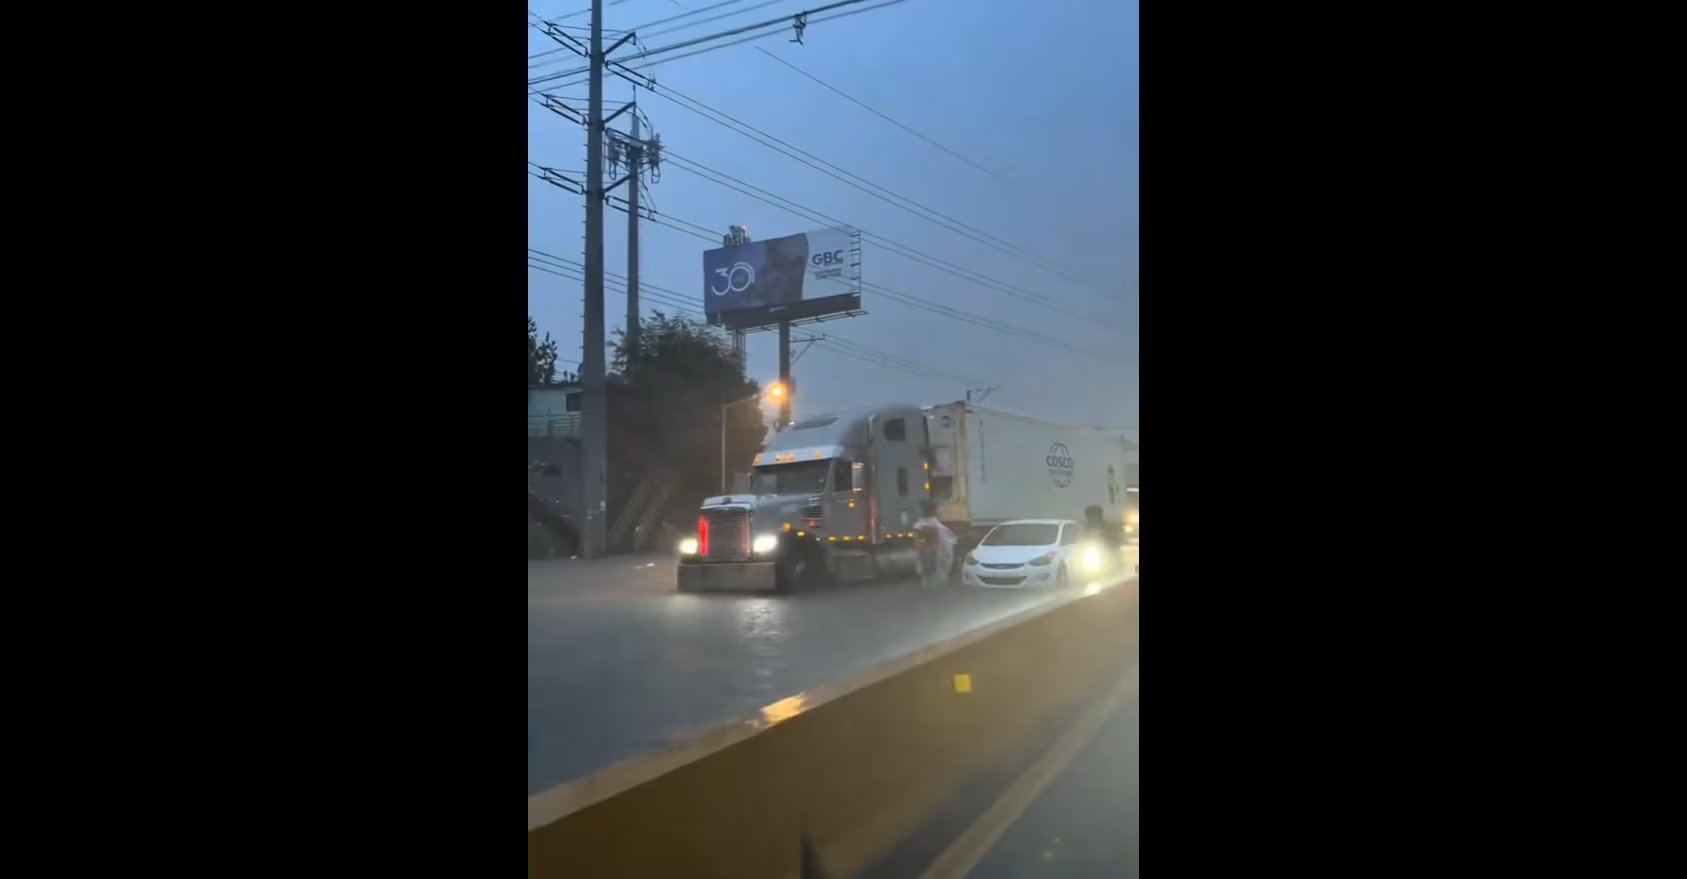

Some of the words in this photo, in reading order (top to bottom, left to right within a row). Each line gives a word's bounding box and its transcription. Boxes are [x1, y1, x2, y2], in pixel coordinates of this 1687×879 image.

[812, 250, 844, 266] GBC
[711, 262, 754, 296] 30
[1046, 455, 1073, 468] COSCO
